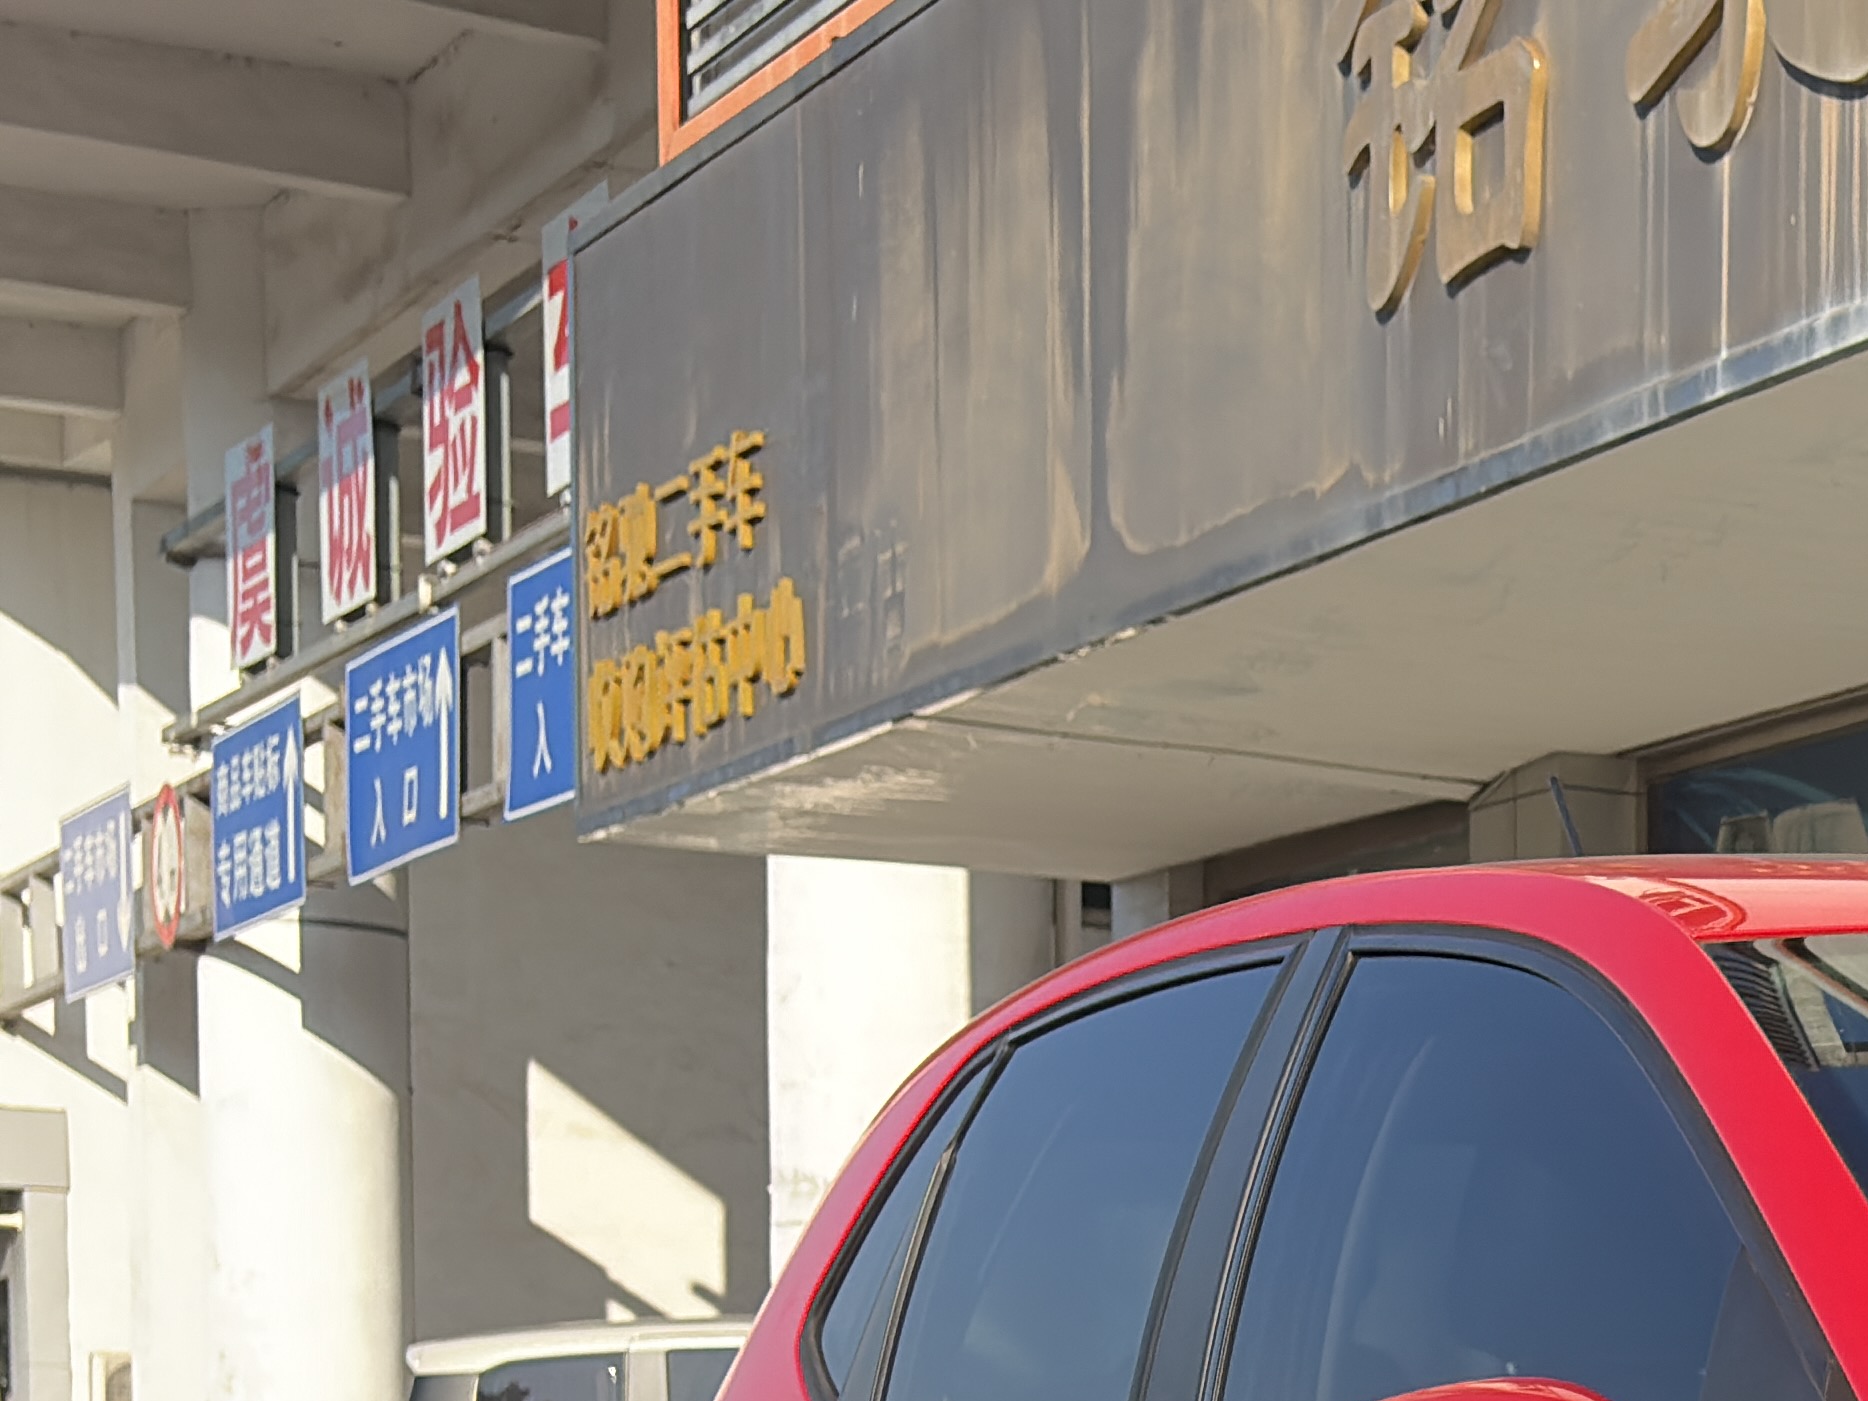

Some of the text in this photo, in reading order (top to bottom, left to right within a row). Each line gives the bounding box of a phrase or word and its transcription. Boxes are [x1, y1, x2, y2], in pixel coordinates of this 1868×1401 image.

[353, 656, 435, 753] 二手车市场
[532, 700, 552, 779] 入
[370, 764, 419, 848] 入口
